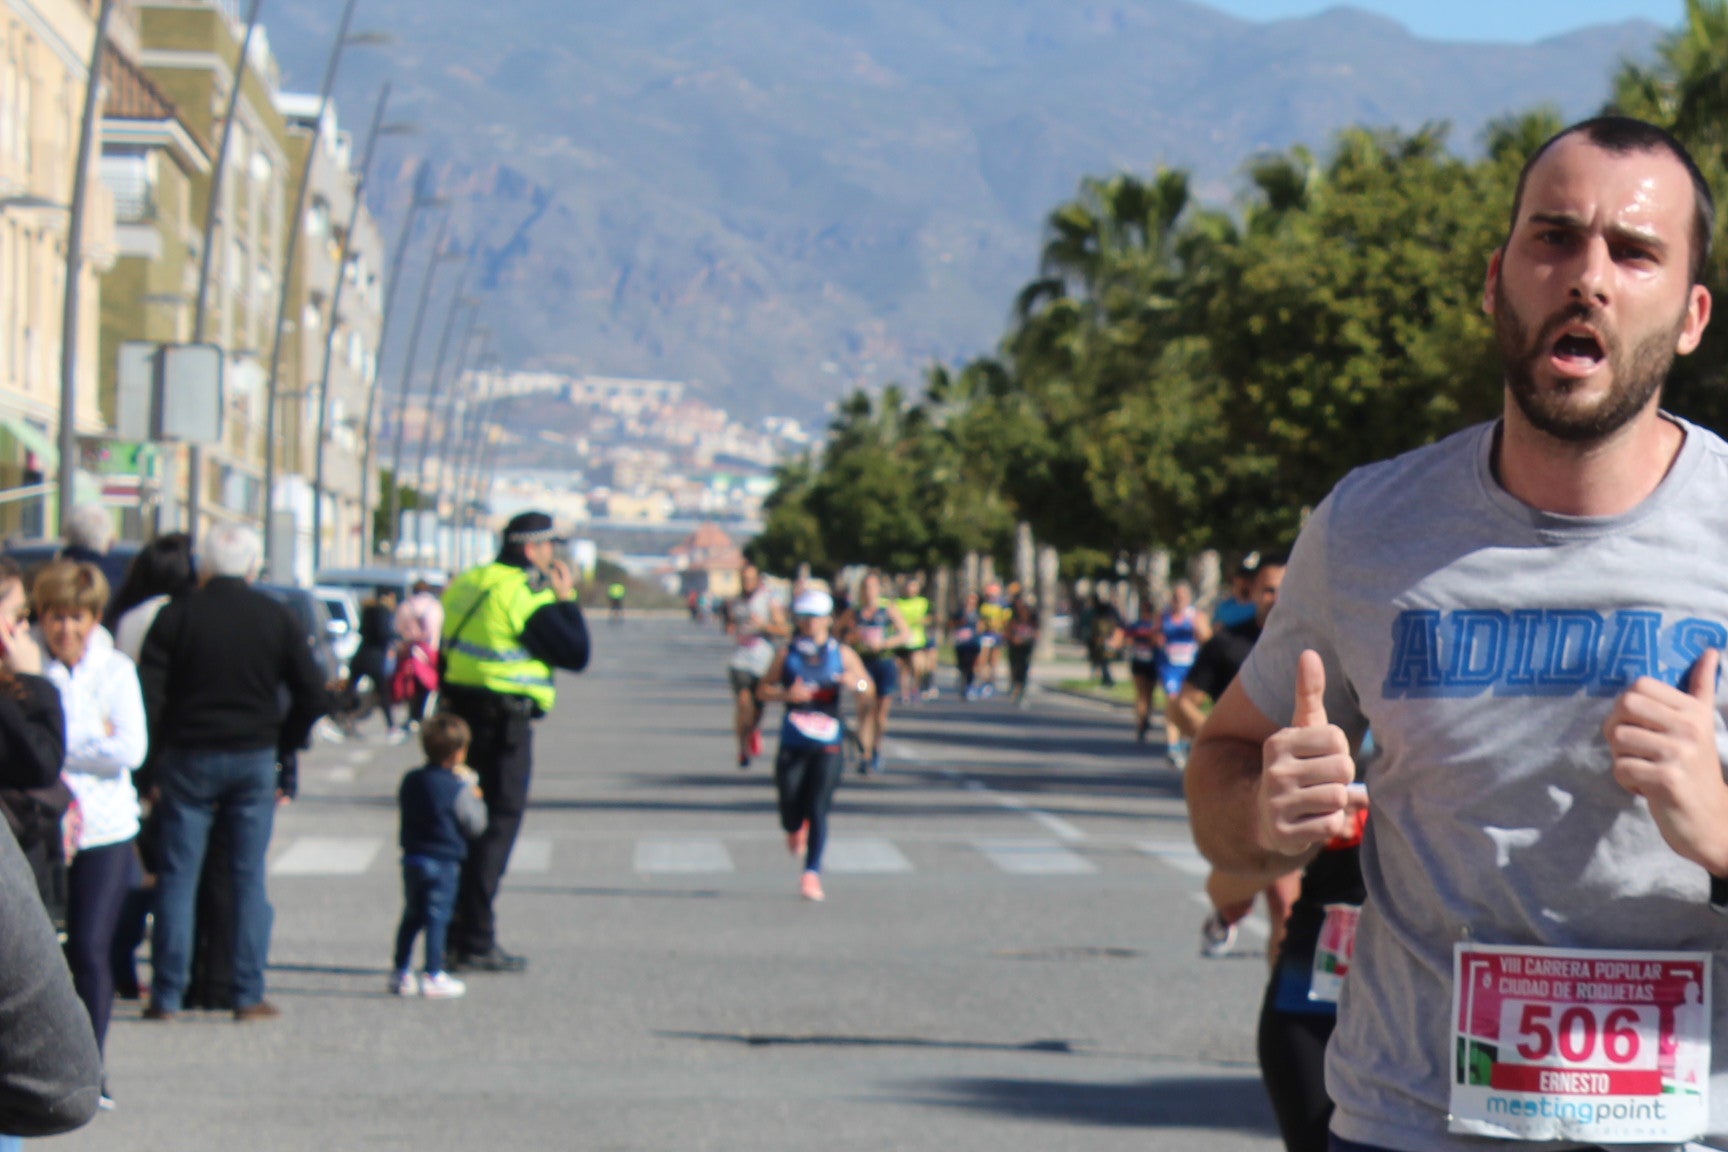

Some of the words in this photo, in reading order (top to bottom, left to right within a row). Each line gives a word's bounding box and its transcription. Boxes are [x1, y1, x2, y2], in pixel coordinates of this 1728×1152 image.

[1500, 956, 1521, 974] VIII
[1525, 957, 1591, 978] CARRERA
[1595, 962, 1662, 980] POPULAR
[1499, 977, 1548, 996] CIUDAD
[1553, 980, 1573, 998] DE
[1577, 982, 1655, 1000] ROQUETAS
[1516, 1004, 1641, 1064] 506
[1539, 1071, 1610, 1094] ERNESTO
[1487, 1096, 1666, 1124] meetingpoint
